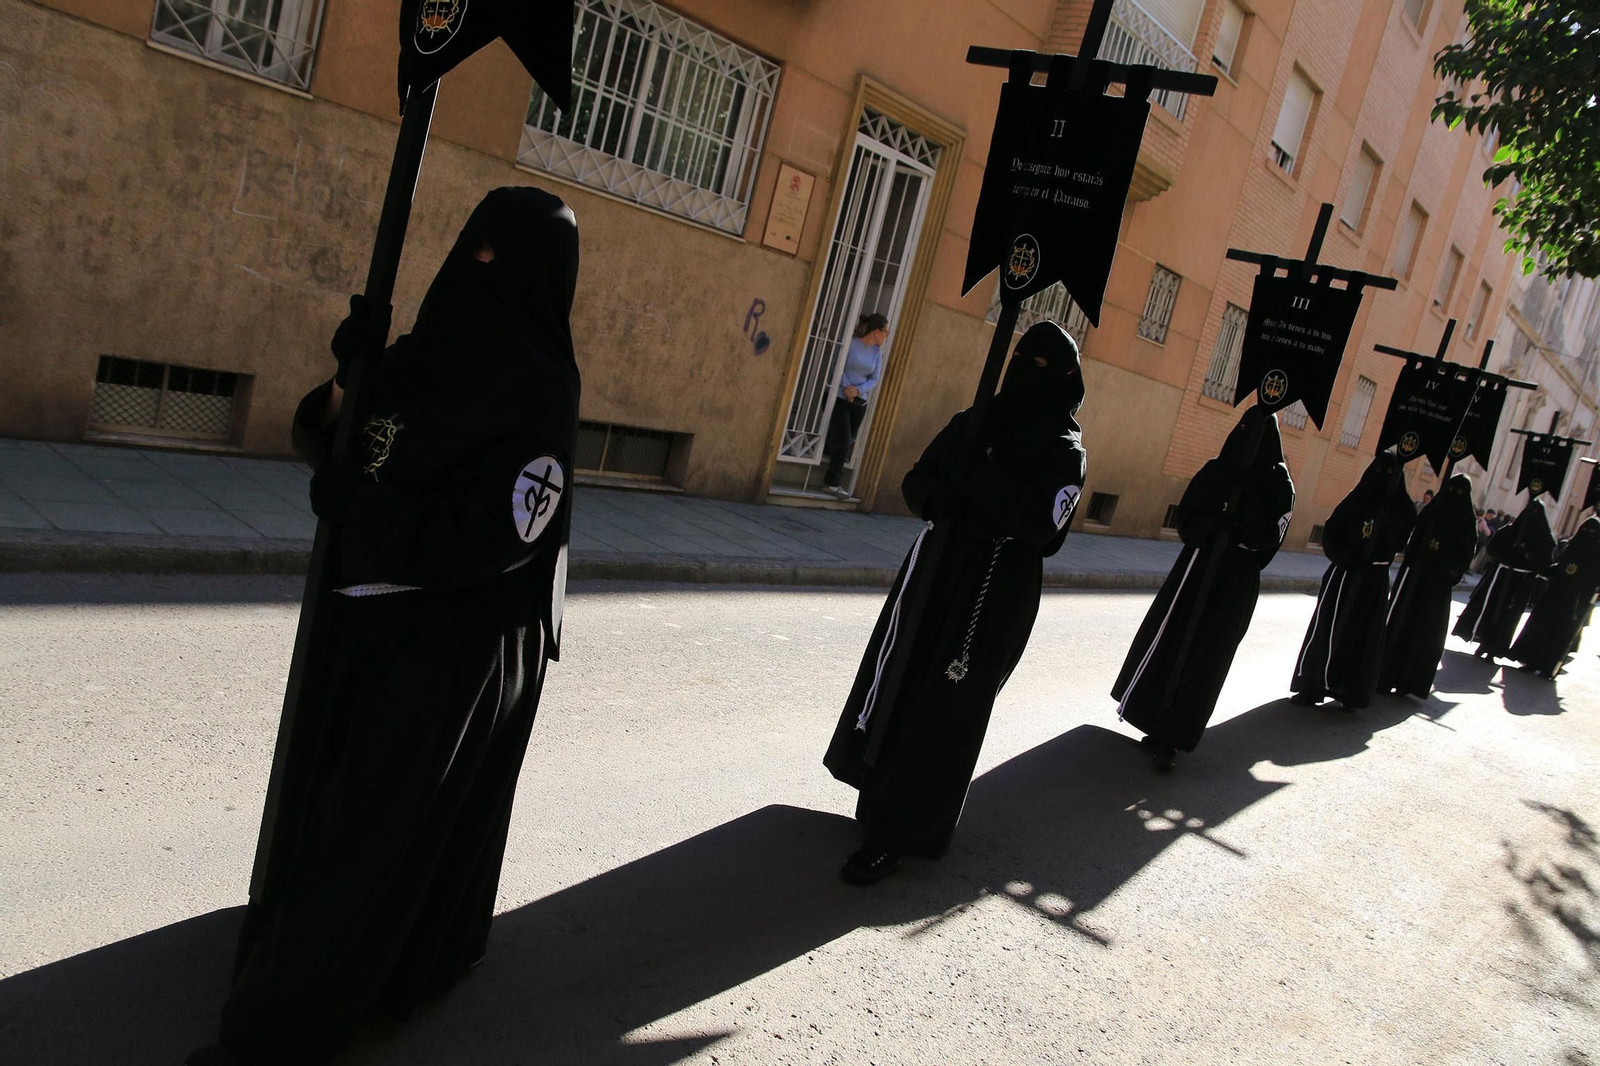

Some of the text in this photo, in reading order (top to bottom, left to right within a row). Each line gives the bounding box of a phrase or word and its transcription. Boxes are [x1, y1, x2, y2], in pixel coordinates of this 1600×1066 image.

[1050, 119, 1067, 138] II
[1290, 296, 1312, 311] III
[1425, 380, 1440, 390] IV
